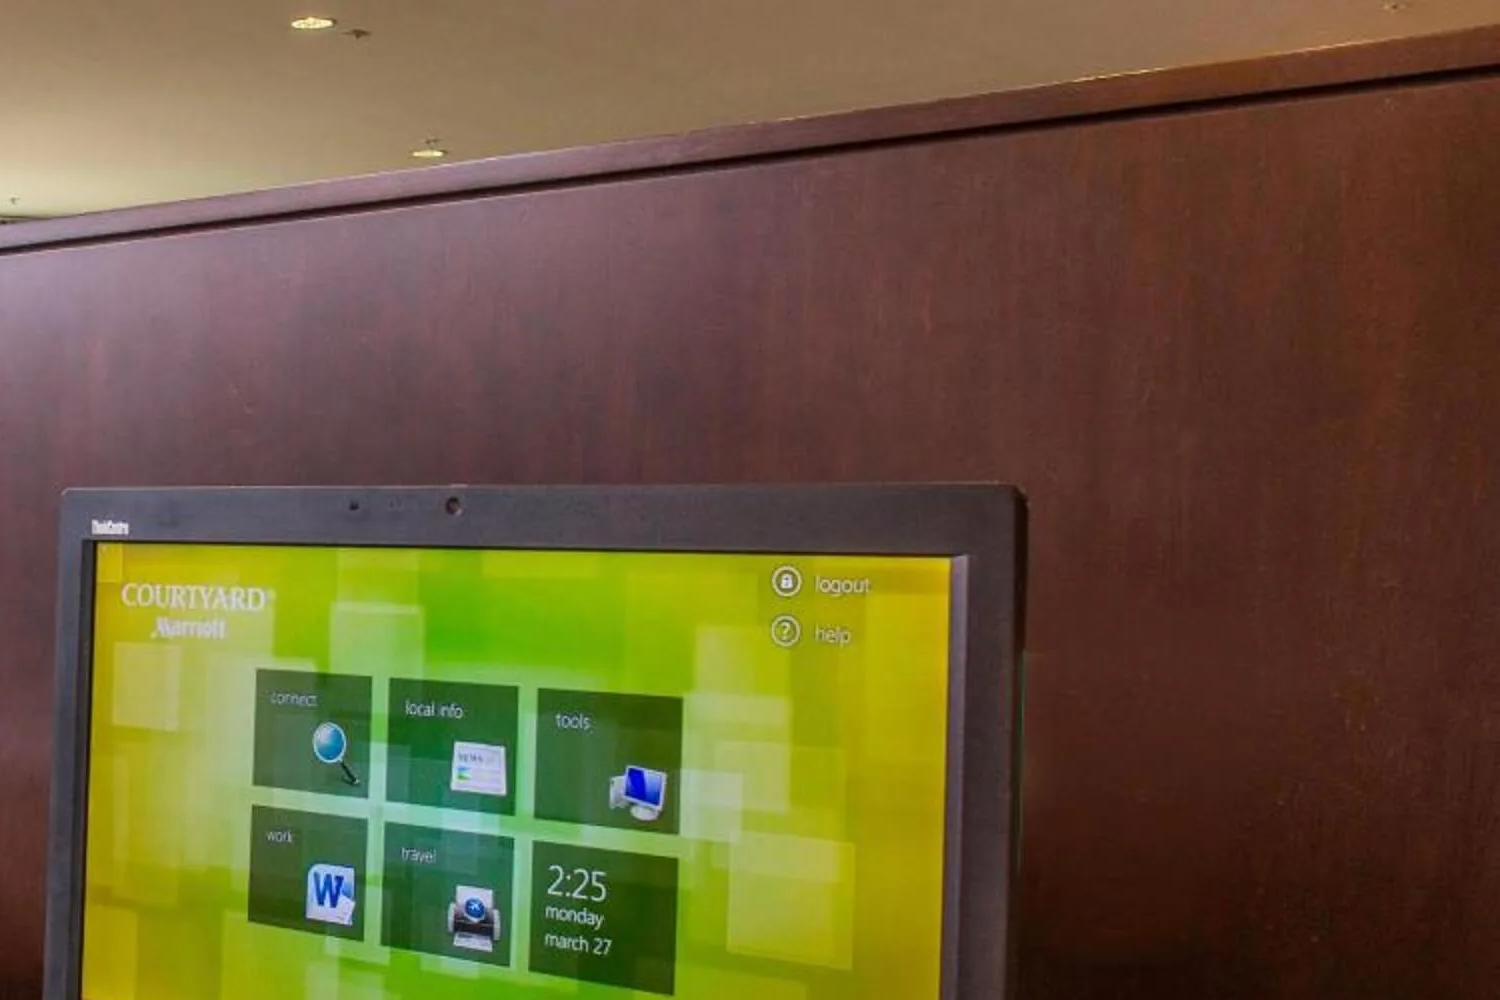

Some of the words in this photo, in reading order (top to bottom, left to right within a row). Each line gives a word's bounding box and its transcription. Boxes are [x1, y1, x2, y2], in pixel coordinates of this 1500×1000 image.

[815, 574, 870, 596] logout
[121, 582, 267, 612] COURTYARD
[151, 616, 226, 639] Marriott
[815, 626, 851, 646] help
[269, 690, 318, 708] connect
[404, 698, 435, 719] local
[439, 701, 464, 720] info
[555, 711, 592, 731] tools
[266, 828, 293, 844] work
[400, 845, 437, 866] travel
[546, 863, 608, 903] 2:25
[544, 904, 605, 932] monday
[544, 932, 590, 954] march
[592, 937, 614, 956] 27
